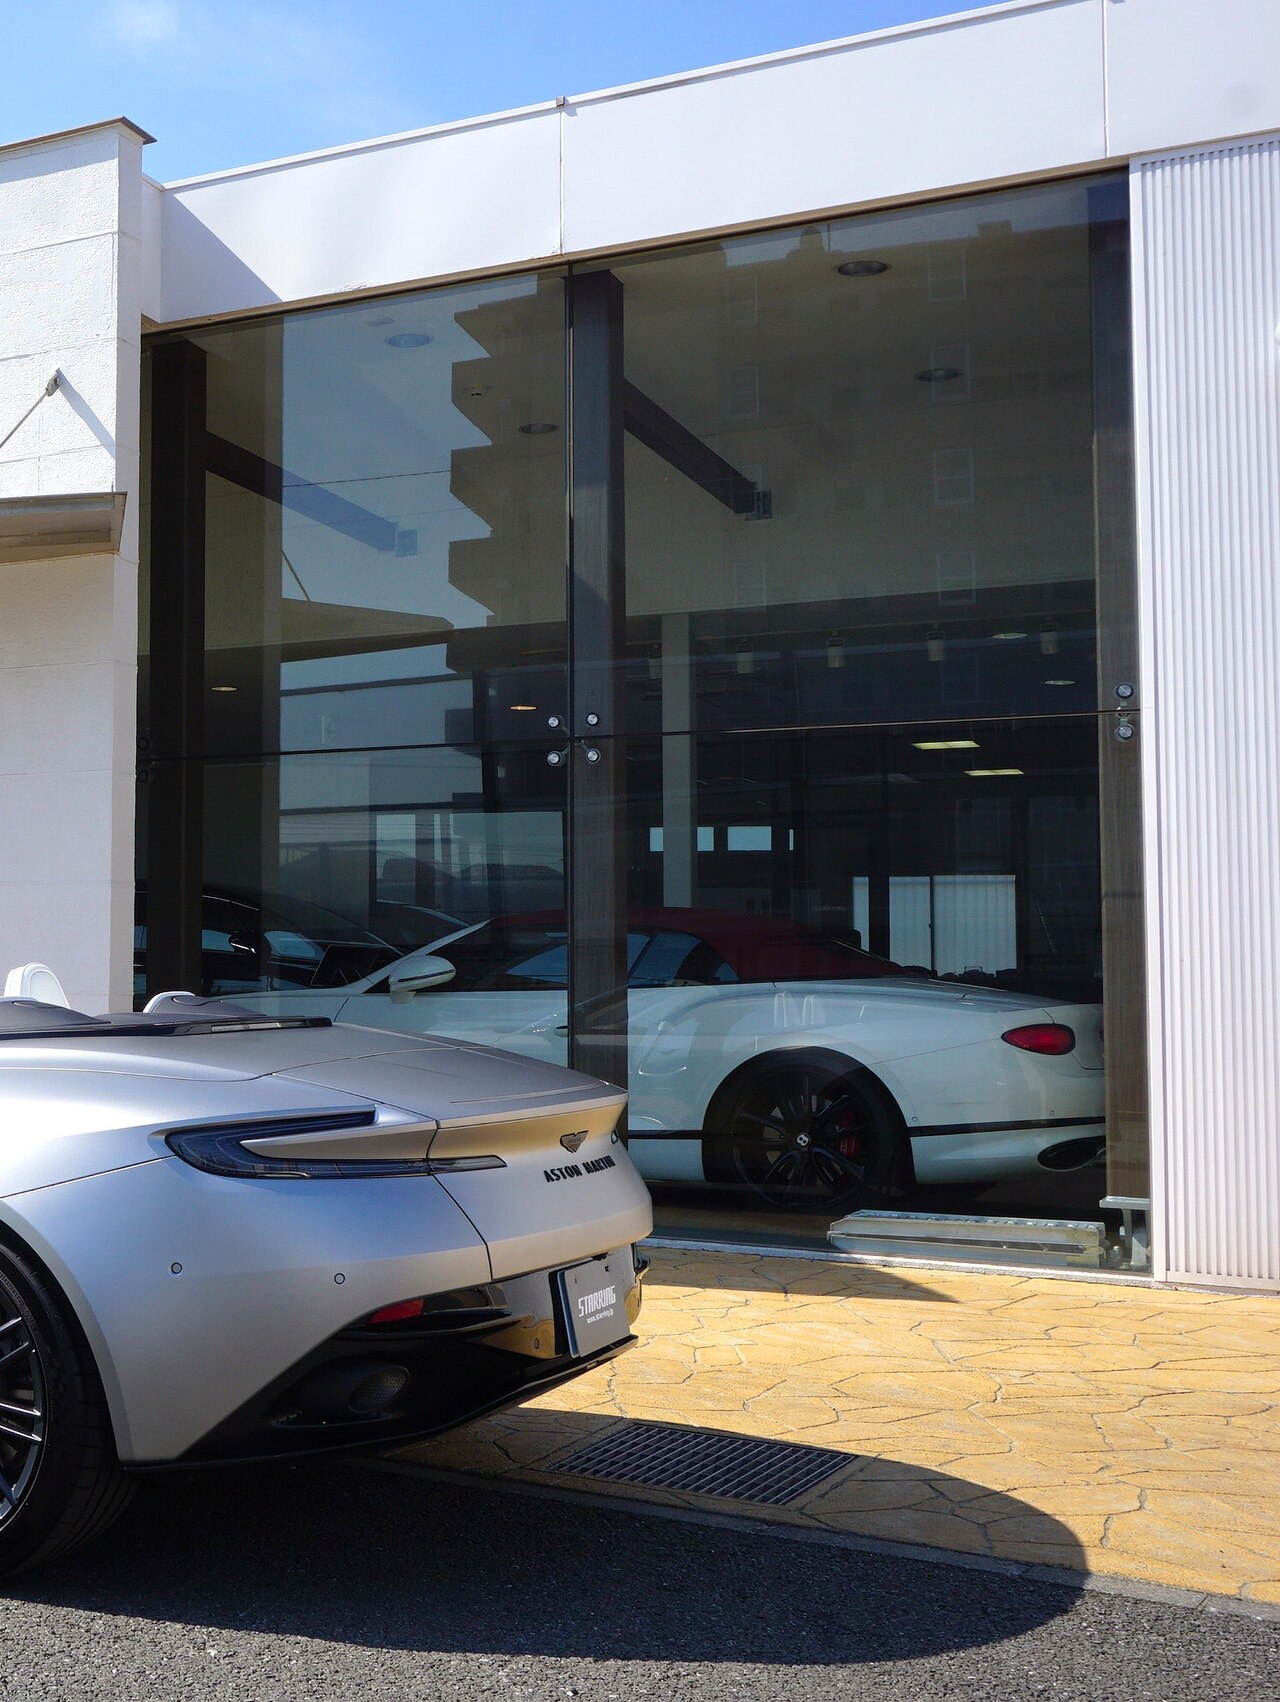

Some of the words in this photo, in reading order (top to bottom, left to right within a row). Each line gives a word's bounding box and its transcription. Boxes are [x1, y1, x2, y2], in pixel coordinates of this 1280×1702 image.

[543, 1164, 583, 1183] ASTON
[582, 1155, 616, 1174] MARTIN
[578, 1285, 616, 1317] STARRING
